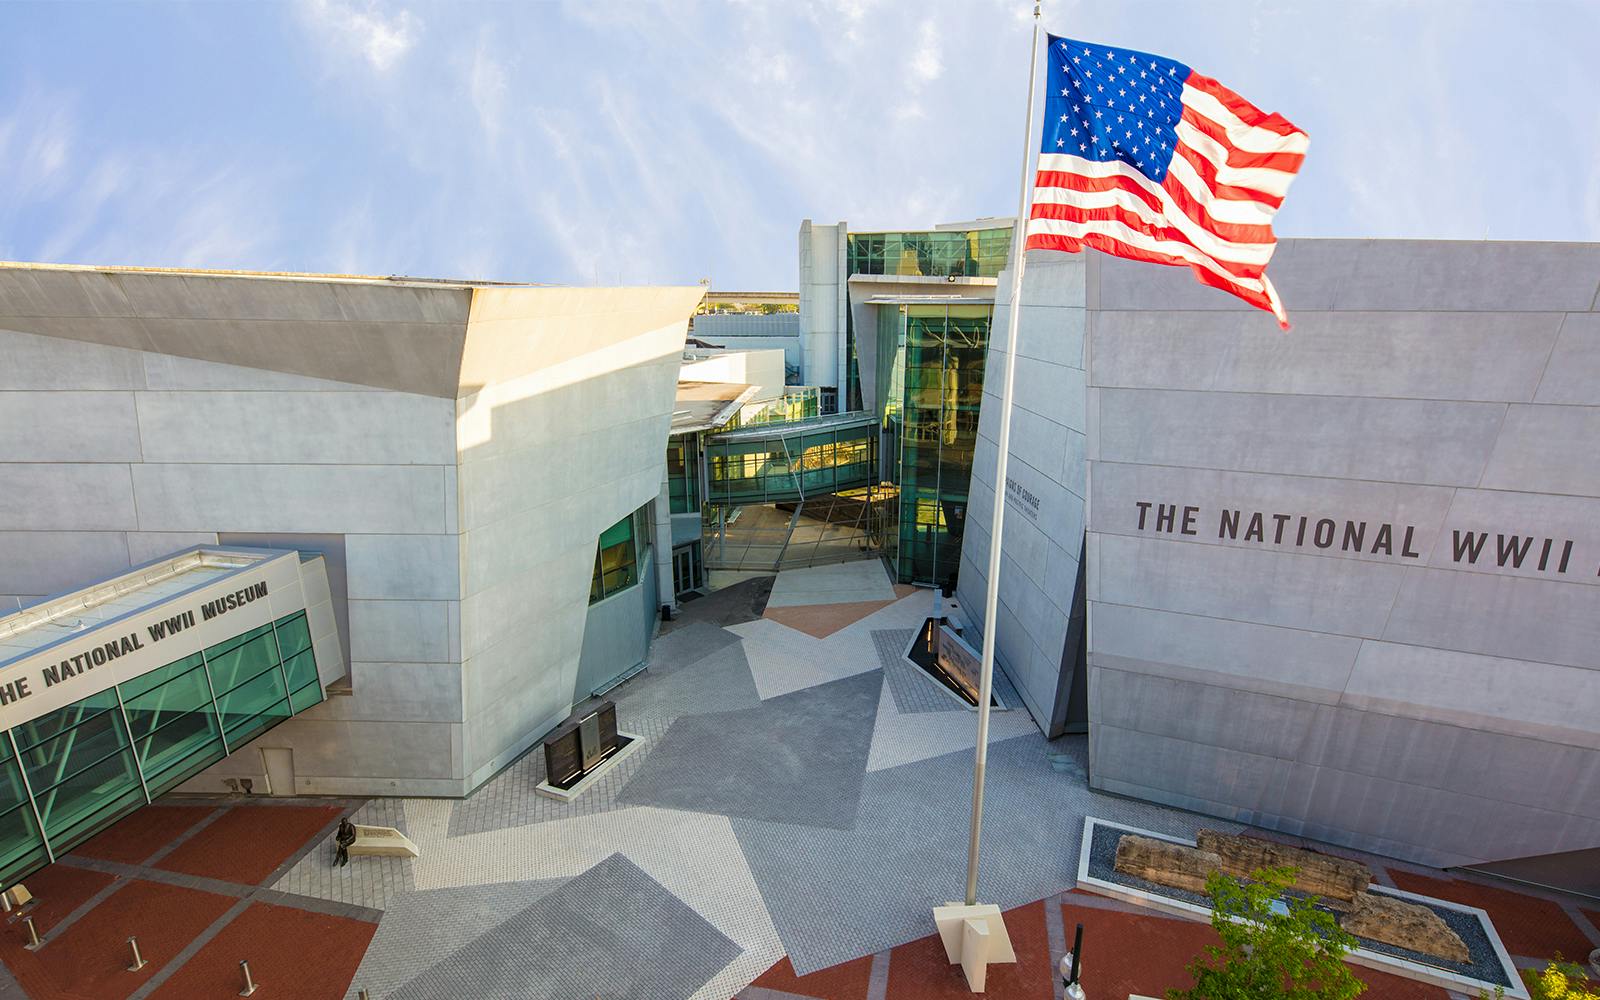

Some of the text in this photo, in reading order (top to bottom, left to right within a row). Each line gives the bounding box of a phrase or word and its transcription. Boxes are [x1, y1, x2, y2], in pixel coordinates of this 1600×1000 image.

[1022, 488, 1040, 510] COURAGE
[1135, 501, 1574, 574] THE NATIONAL WWII
[42, 632, 145, 688] NATIONAL
[147, 610, 196, 642] WWII
[201, 580, 269, 621] MUSEUM
